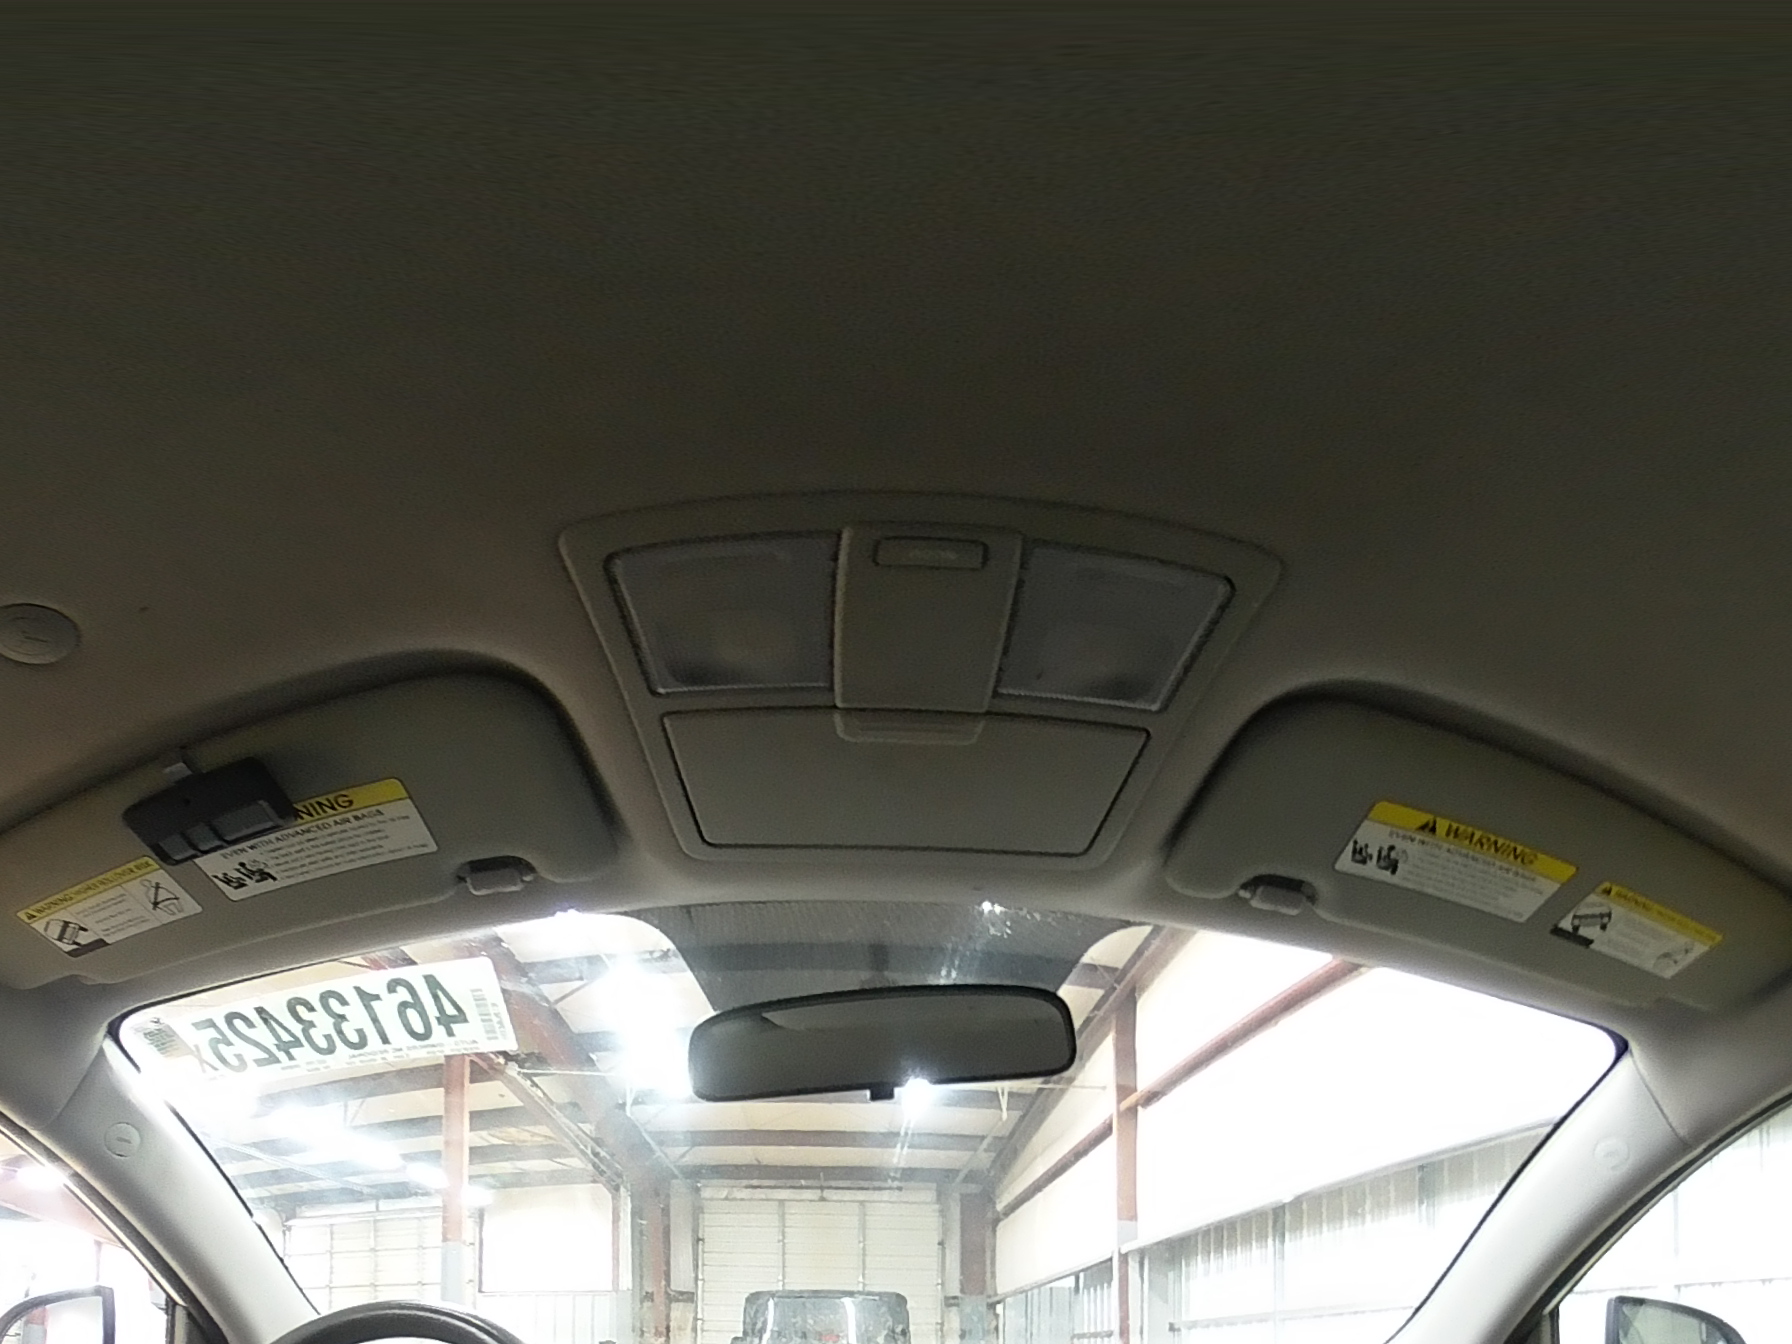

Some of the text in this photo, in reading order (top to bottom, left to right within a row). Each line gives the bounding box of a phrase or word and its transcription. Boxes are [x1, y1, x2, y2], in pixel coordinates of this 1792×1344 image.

[293, 792, 355, 822] NING
[275, 821, 334, 844] ADVANCED
[334, 816, 352, 828] AIR
[1445, 821, 1539, 867] WARNING
